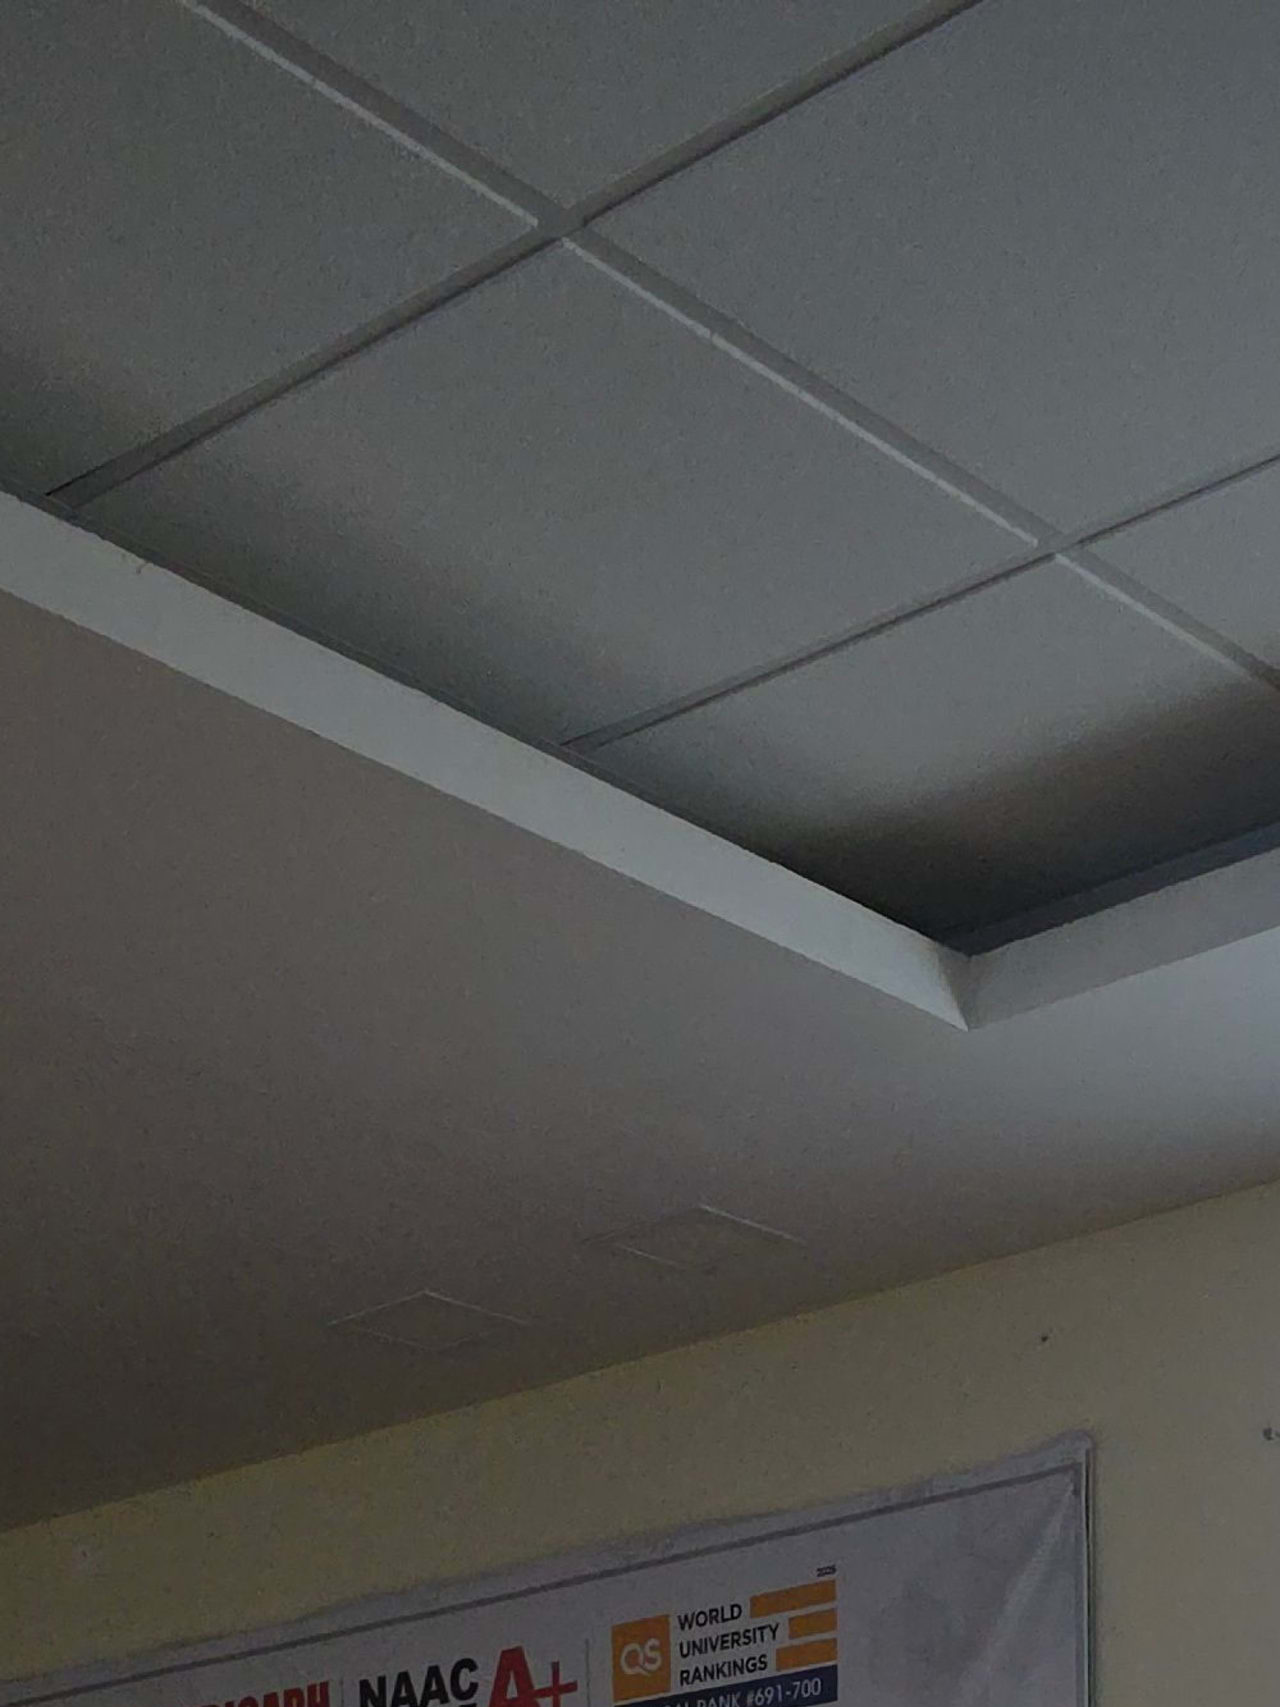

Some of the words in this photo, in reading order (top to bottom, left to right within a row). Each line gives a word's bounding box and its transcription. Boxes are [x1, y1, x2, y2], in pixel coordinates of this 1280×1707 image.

[677, 1604, 742, 1631] WORLD
[621, 1637, 663, 1677] QS
[679, 1623, 780, 1658] UNIVERSITY
[679, 1654, 768, 1686] RANKINGS
